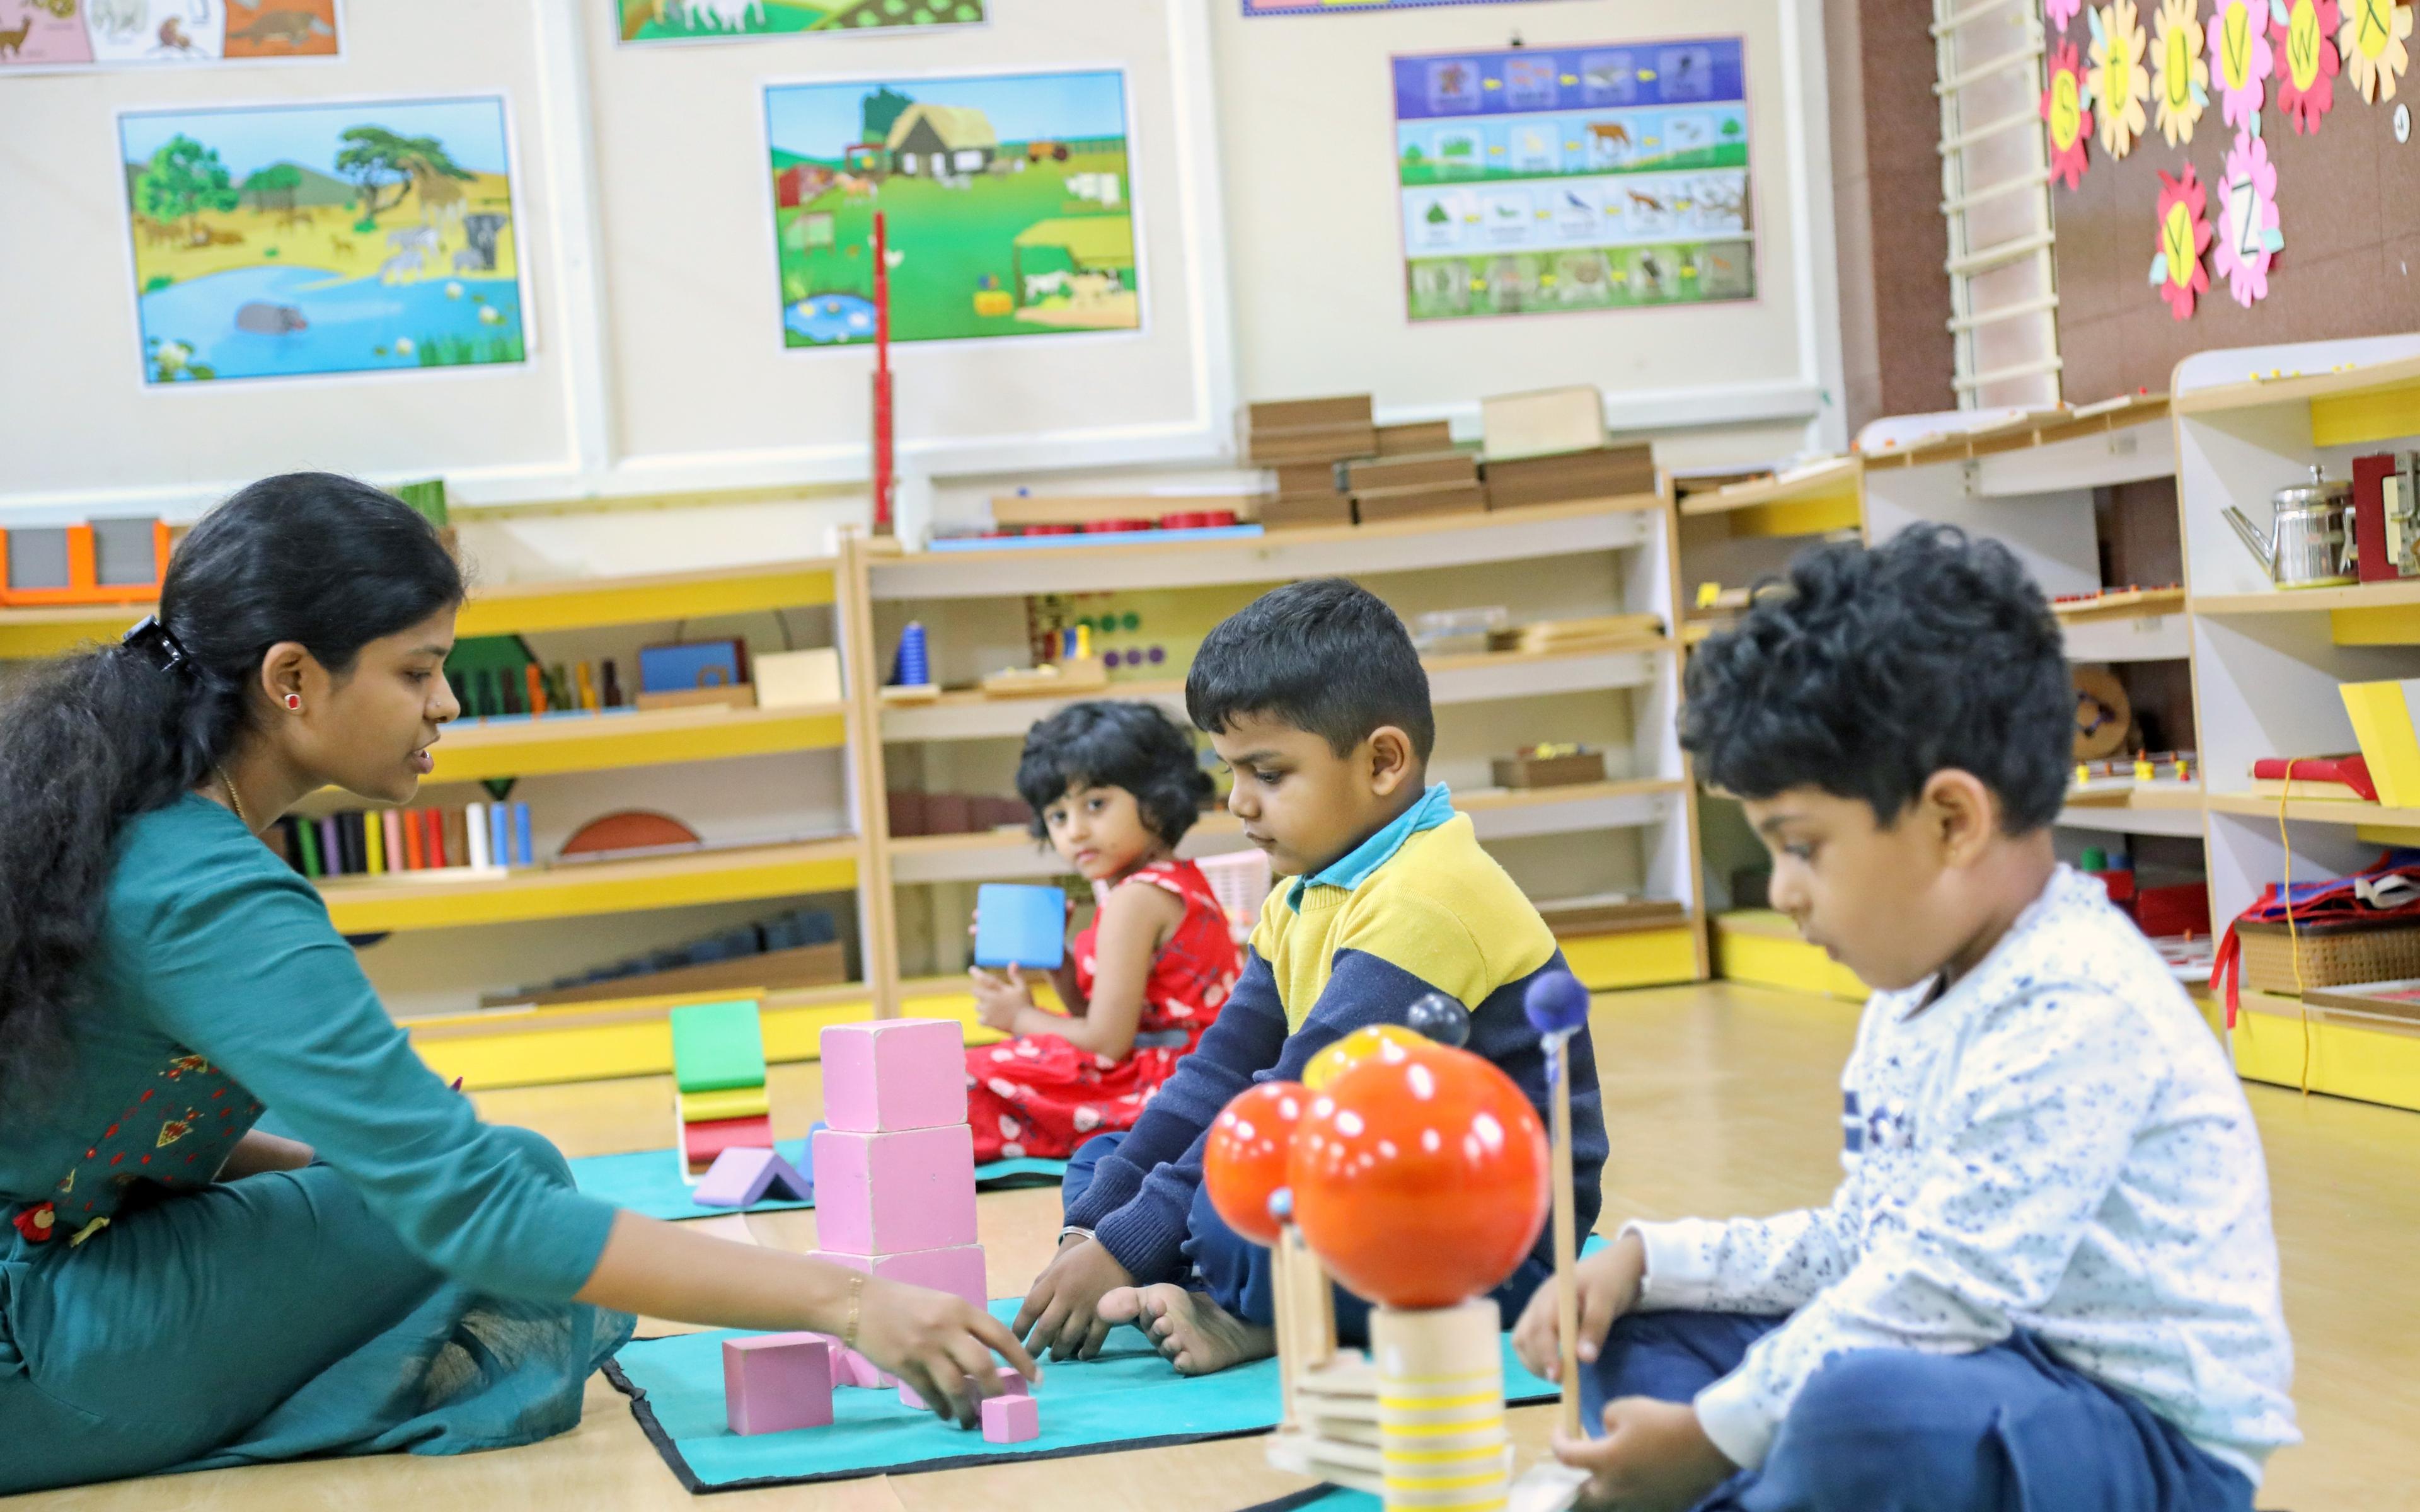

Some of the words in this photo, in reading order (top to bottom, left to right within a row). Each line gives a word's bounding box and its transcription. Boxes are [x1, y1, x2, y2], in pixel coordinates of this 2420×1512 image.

[2225, 11, 2248, 82] V
[2290, 14, 2315, 74] W
[2232, 181, 2261, 255] Z
